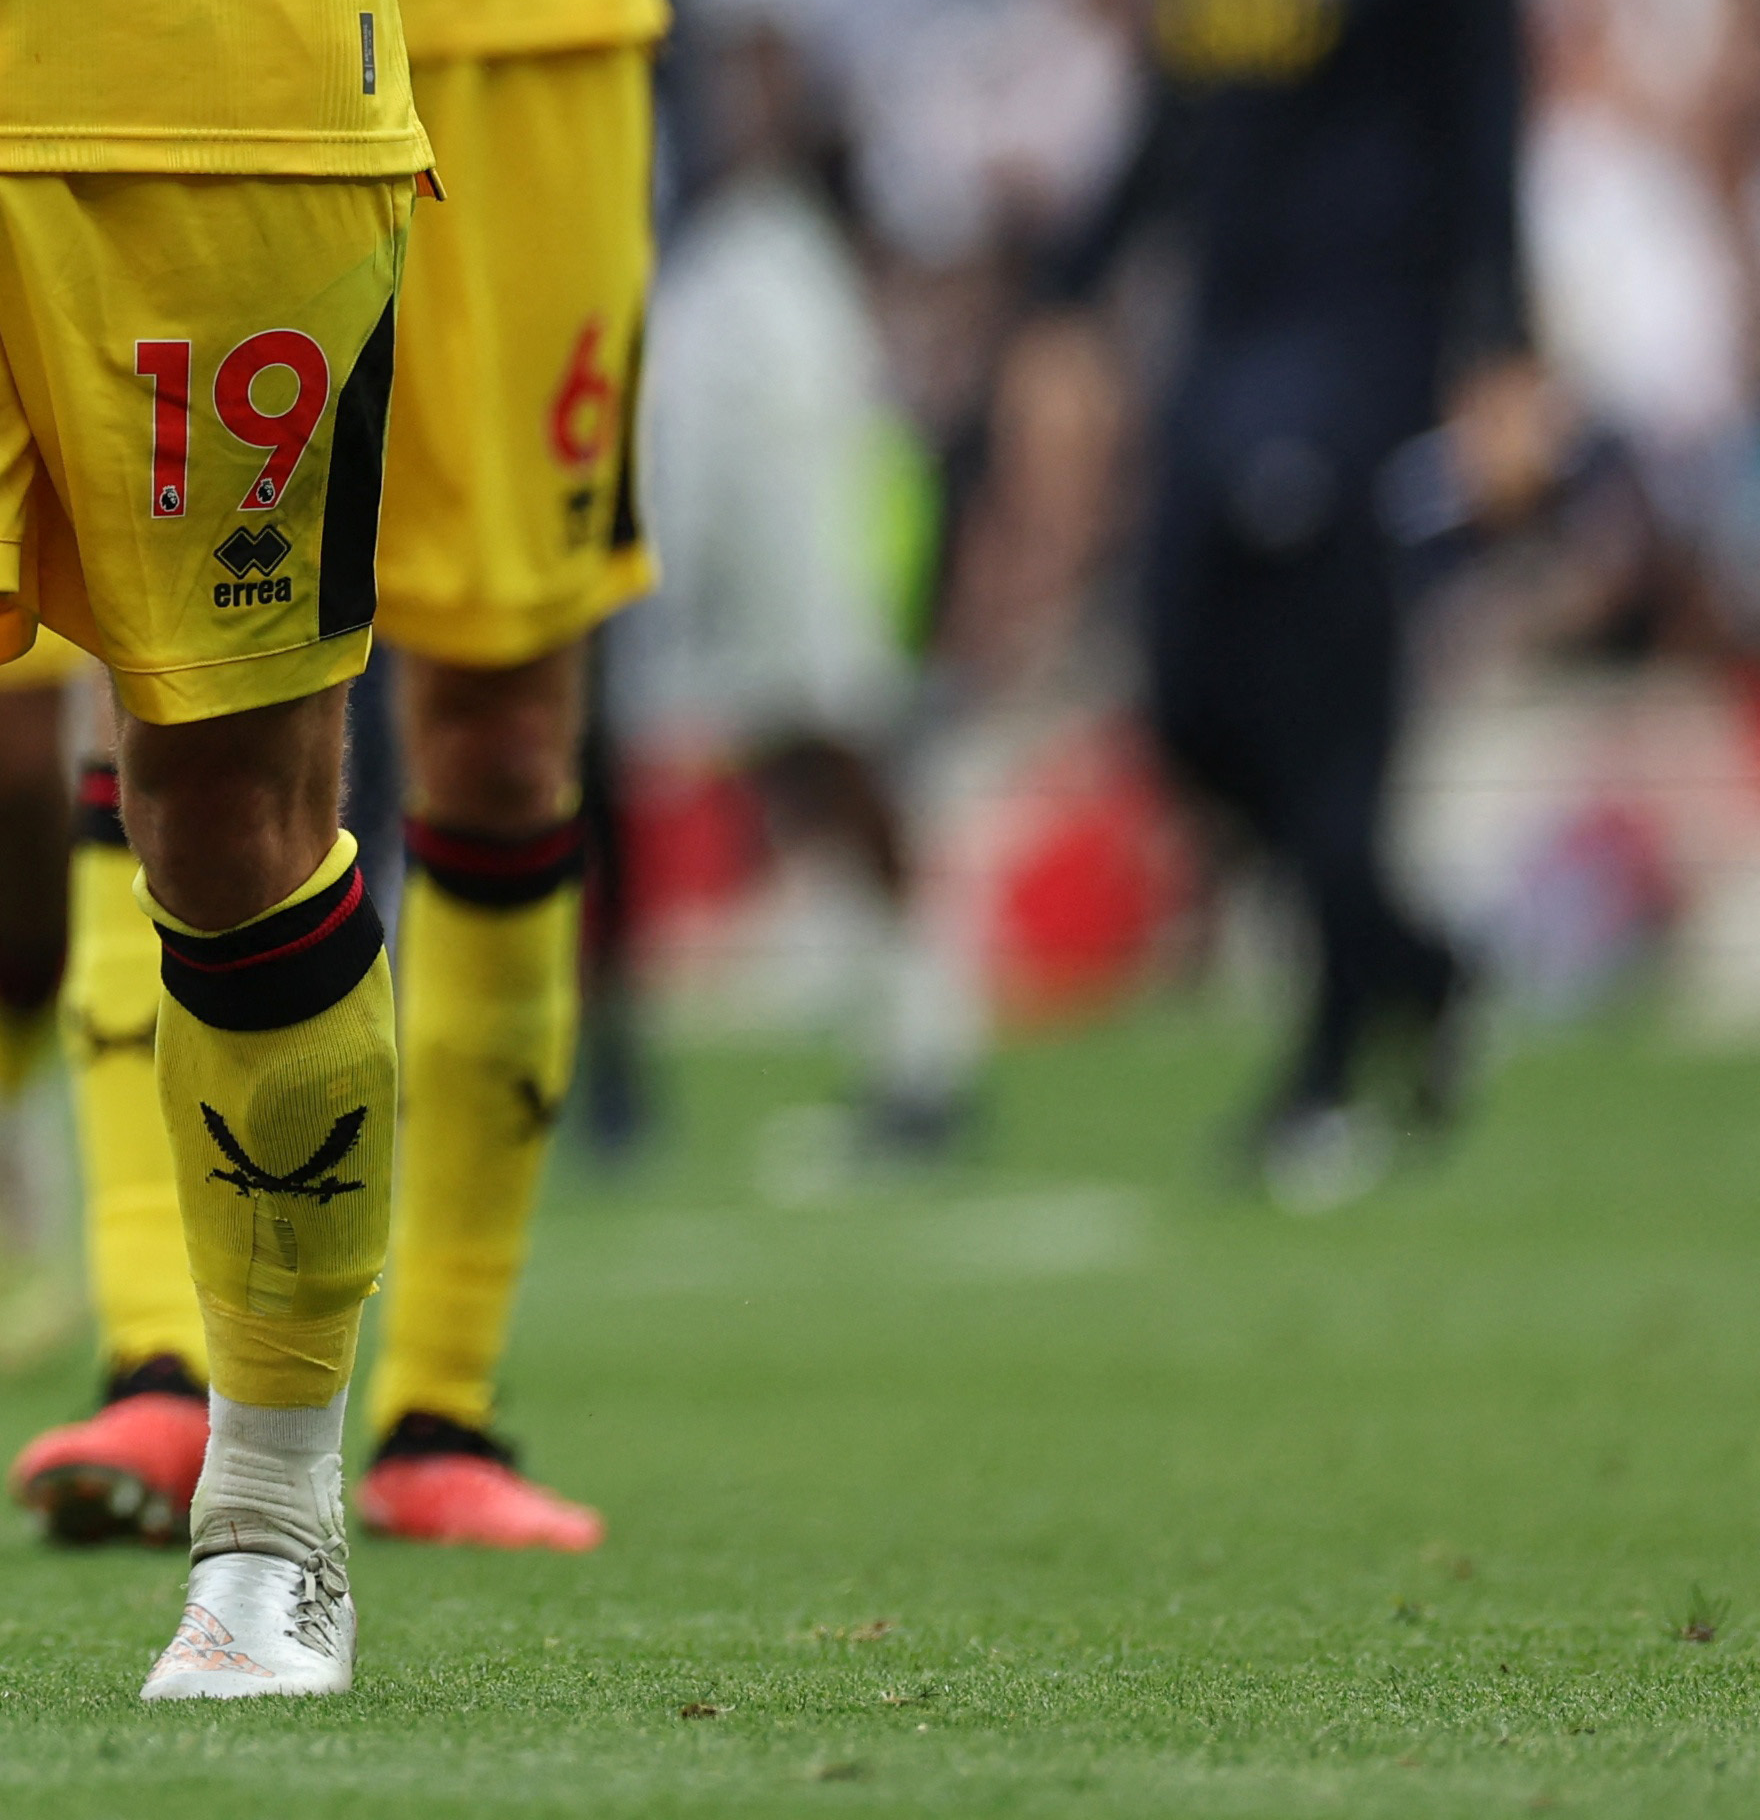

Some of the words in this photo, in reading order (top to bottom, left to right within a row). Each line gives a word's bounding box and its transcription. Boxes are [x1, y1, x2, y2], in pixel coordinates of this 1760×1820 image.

[135, 327, 331, 519] 19
[543, 313, 620, 475] 6
[214, 576, 292, 608] errea
